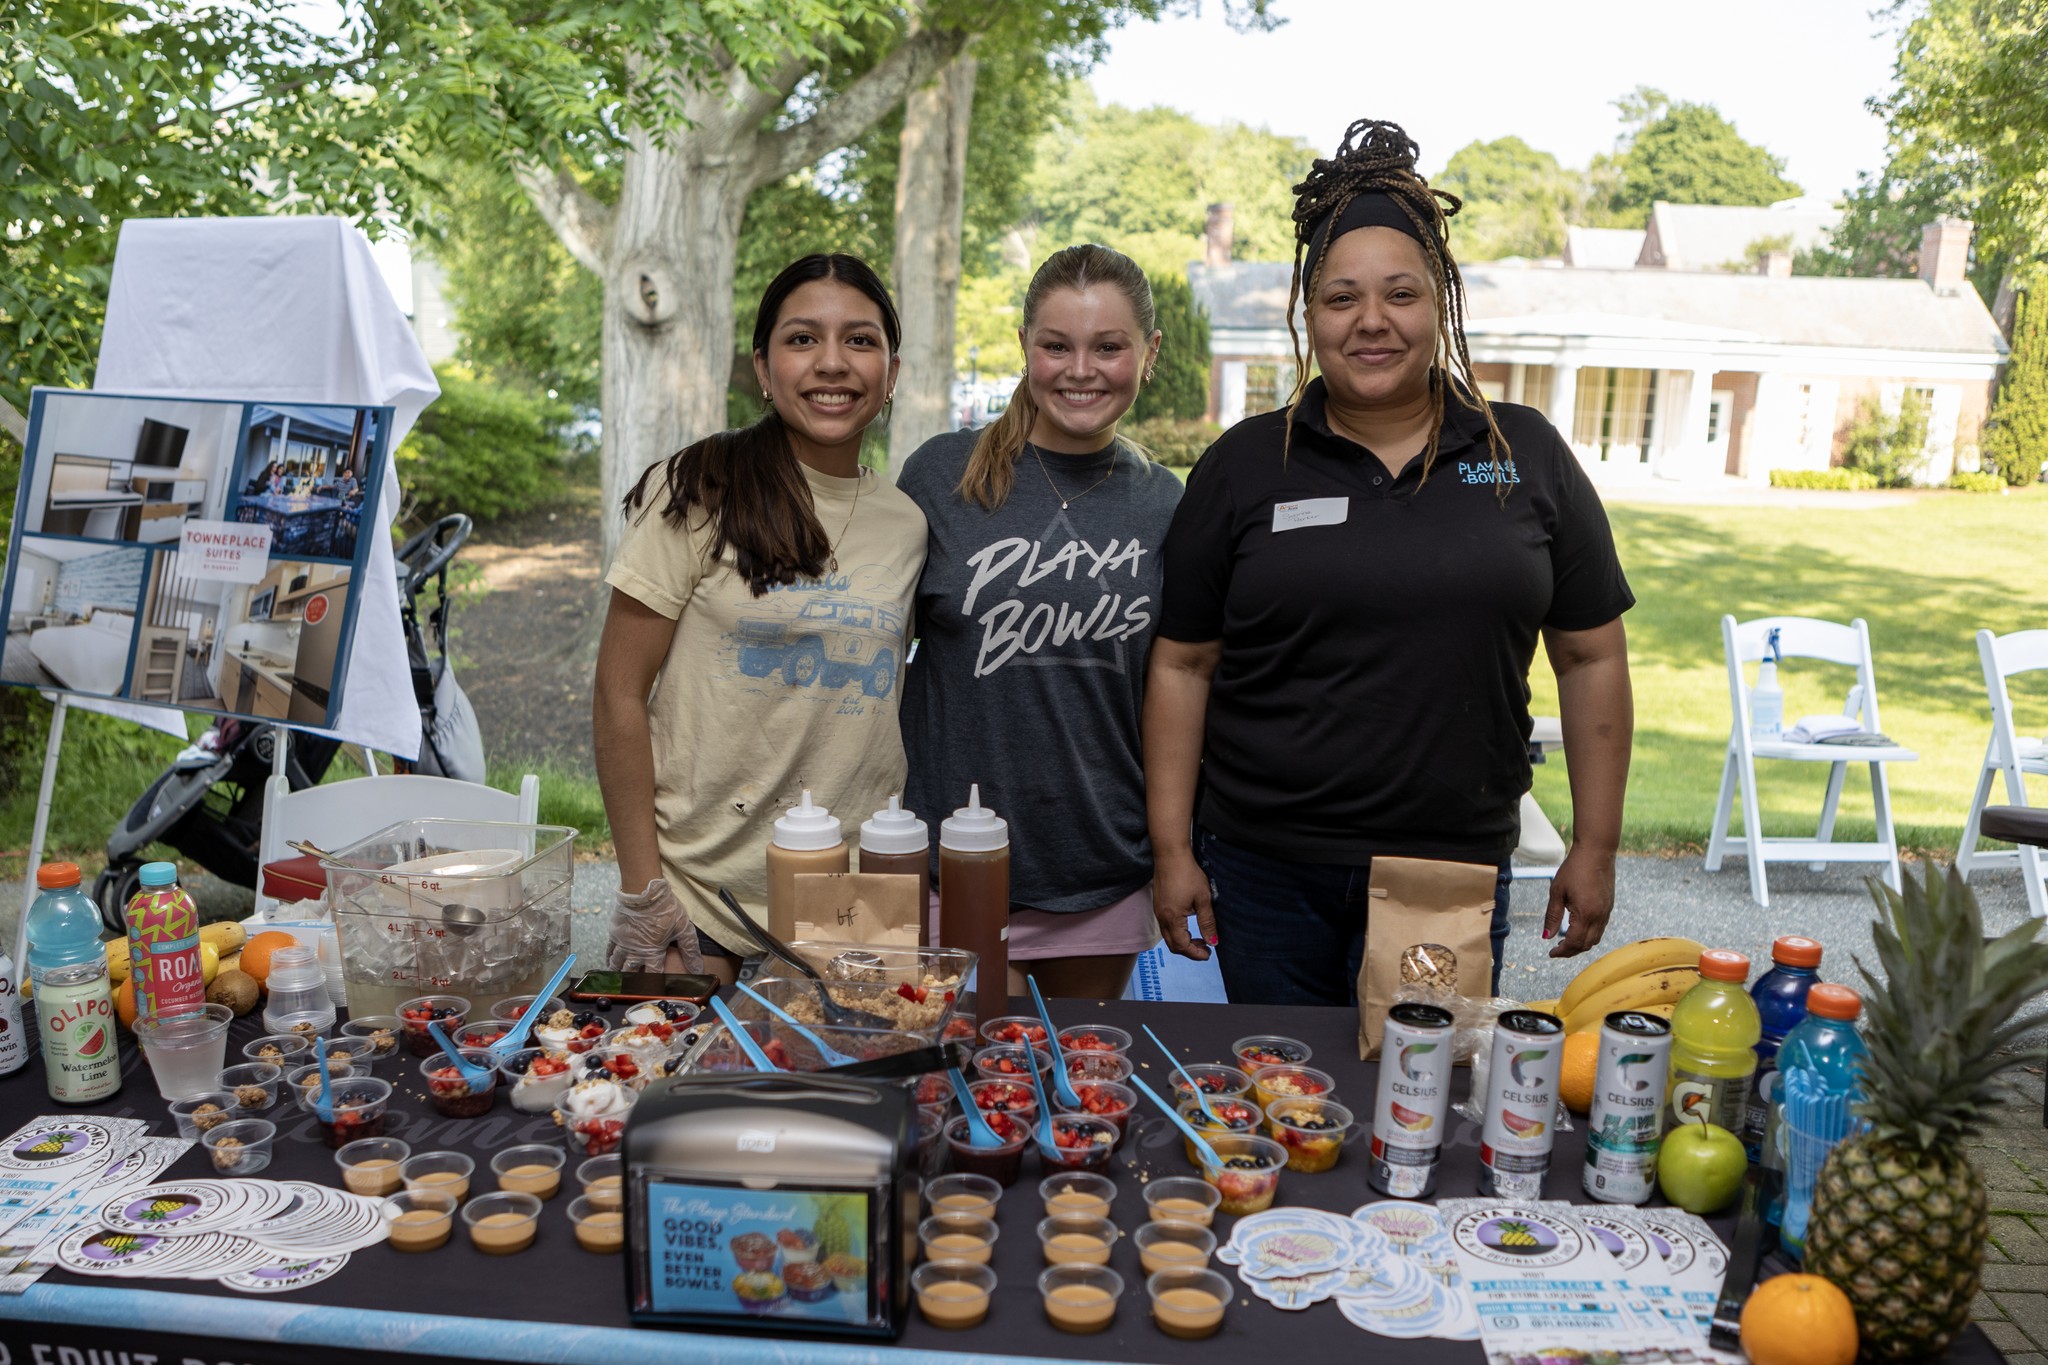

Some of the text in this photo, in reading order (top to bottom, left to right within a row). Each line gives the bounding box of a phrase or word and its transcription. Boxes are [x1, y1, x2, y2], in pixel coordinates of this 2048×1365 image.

[1458, 461, 1504, 474] PLAYA
[1467, 472, 1520, 484] BOWLS
[187, 531, 266, 548] TOWNEPLACE
[206, 548, 242, 560] SUITES
[962, 537, 1148, 616] PLAYA
[974, 593, 1151, 679] BOWLS
[836, 706, 864, 715] 2014
[160, 996, 188, 1004] CUCUMBER
[61, 1054, 118, 1073] Watermelon
[81, 1069, 108, 1082] Lime
[1392, 1082, 1438, 1097] CELSIUS
[1502, 1089, 1549, 1104] CELSIUS
[1608, 1092, 1655, 1106] CELSIUS
[1673, 1081, 1713, 1125] G
[14, 1124, 105, 1146] PLAYA BOWLS
[36, 1160, 60, 1168] ACAI
[64, 1153, 86, 1162] SHOP
[108, 1205, 202, 1230] PLAYA BOWLS
[662, 1197, 685, 1215] The
[729, 1202, 798, 1225] Standard
[664, 1218, 722, 1236] GOOD
[1460, 1210, 1570, 1235] PLAYA BOWLS
[664, 1233, 722, 1251] VIBES,
[73, 1257, 134, 1271] BOWLS
[664, 1251, 704, 1263] EVEN
[1487, 1252, 1534, 1264] ORIGINAL
[664, 1264, 722, 1277] BETTER
[263, 1269, 326, 1288] BOWLS
[1530, 1320, 1615, 1328] @PLAYABOWLS
